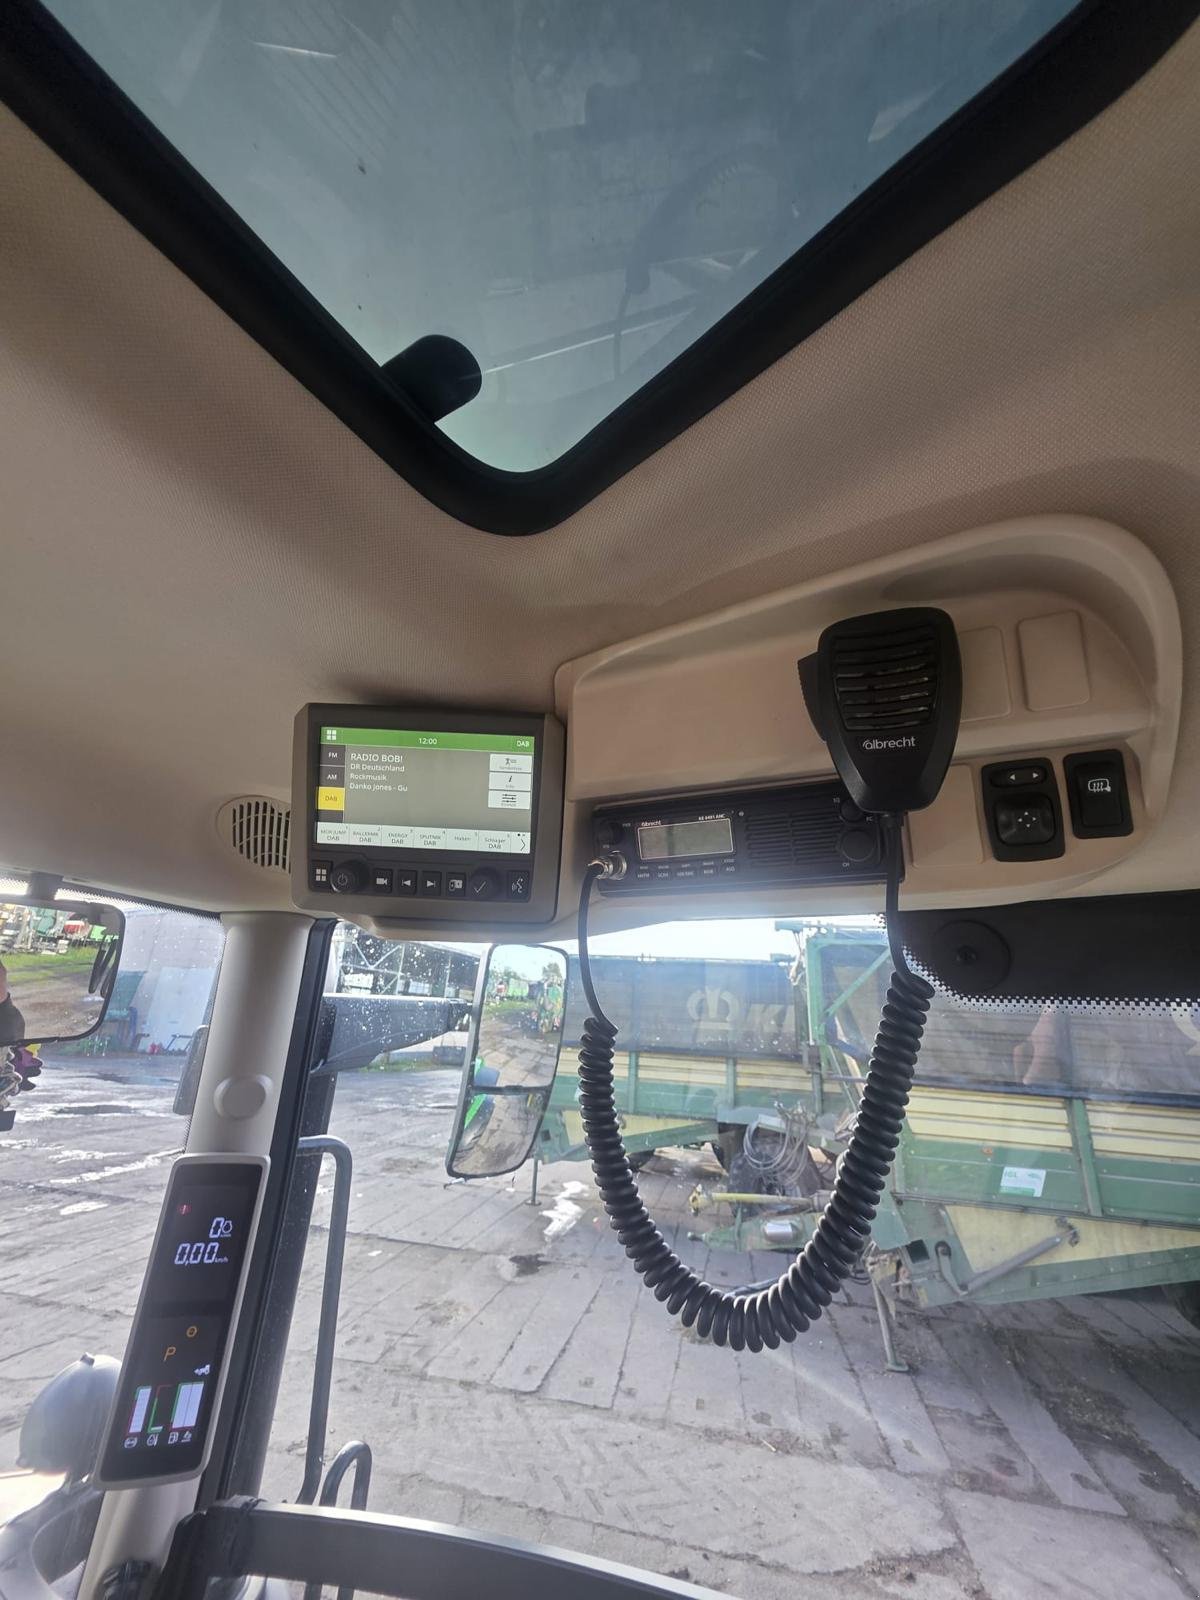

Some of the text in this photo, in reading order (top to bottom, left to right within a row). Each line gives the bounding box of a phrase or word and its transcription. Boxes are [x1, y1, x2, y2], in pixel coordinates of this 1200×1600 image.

[418, 737, 438, 745] 12:00
[862, 736, 916, 750] albrecht
[350, 753, 403, 763] RADIO BOB!
[361, 764, 405, 772] Deutschland
[350, 773, 387, 781] Rockmusik
[349, 782, 372, 790] Danko
[209, 1217, 225, 1238] 0
[174, 1242, 219, 1266] 0,00
[164, 1347, 176, 1361] P
